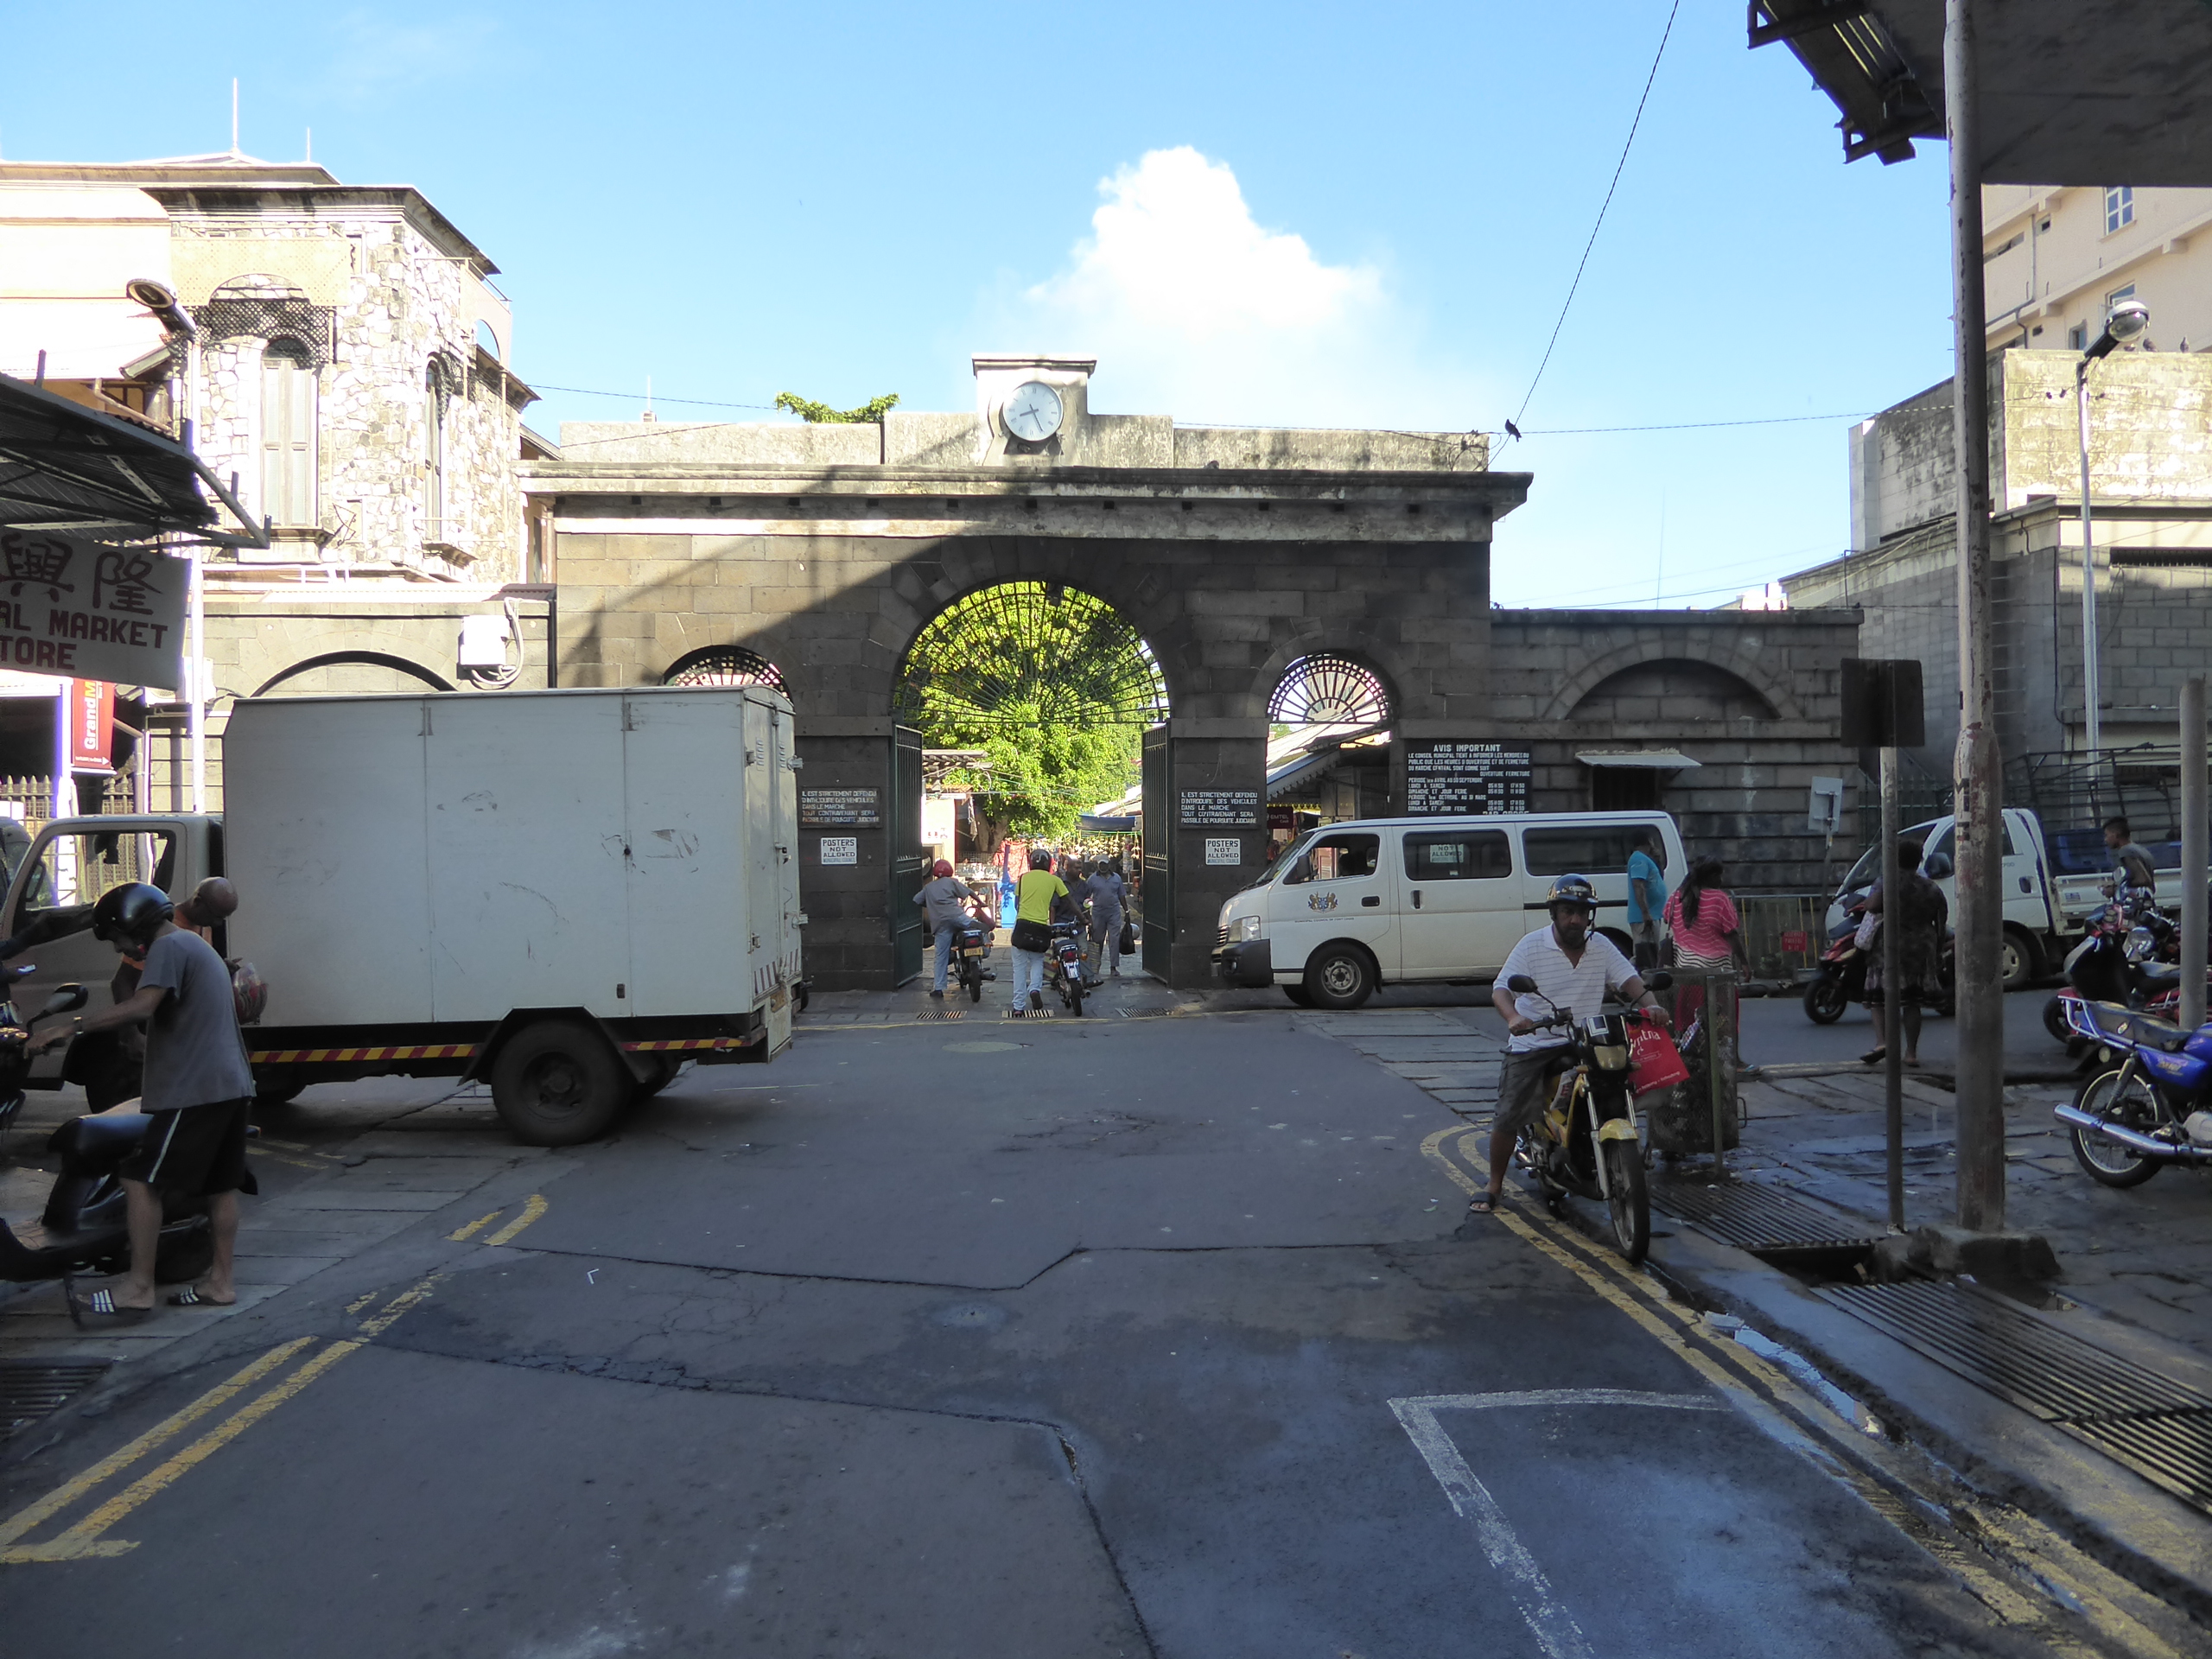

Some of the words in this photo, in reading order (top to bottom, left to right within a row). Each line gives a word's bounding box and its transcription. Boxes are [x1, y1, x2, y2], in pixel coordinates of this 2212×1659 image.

[48, 609, 168, 648] MARKET
[1433, 744, 1452, 752] AVIS
[1456, 744, 1501, 752] IMPORTANT
